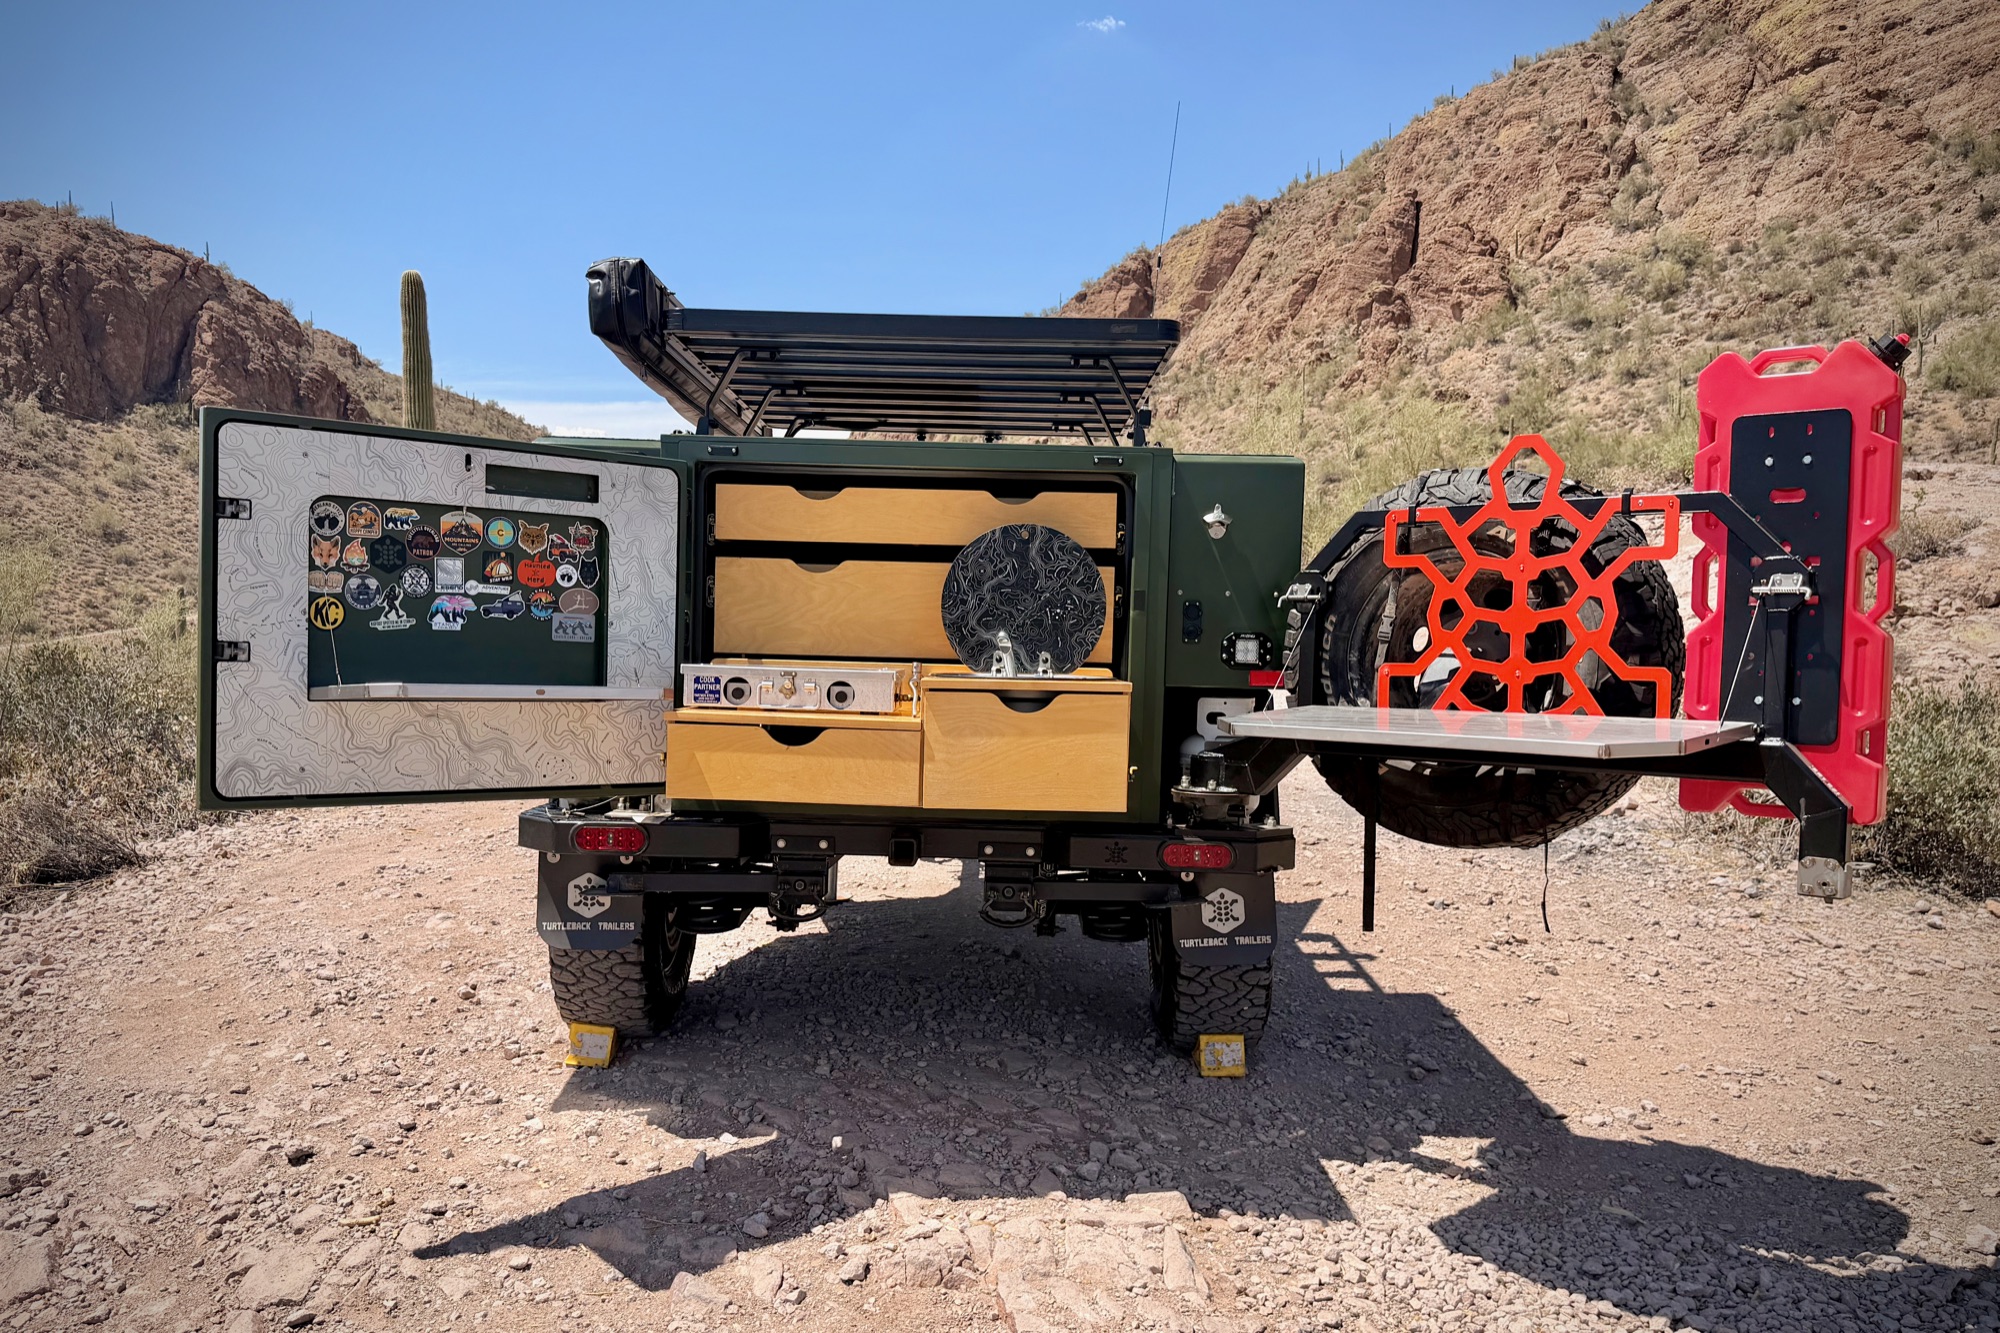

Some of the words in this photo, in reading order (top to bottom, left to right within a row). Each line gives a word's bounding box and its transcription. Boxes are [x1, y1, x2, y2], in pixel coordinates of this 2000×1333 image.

[407, 526, 423, 541] LIFESTYLE
[497, 529, 505, 537] C
[412, 549, 434, 557] PATRON
[313, 598, 340, 628] KC
[700, 675, 715, 683] COOK
[541, 921, 592, 931] TURTLEBACK
[597, 922, 635, 931] TRAILERS
[1179, 937, 1229, 948] TURTLEBACK
[1234, 935, 1272, 946] TRAILERS
